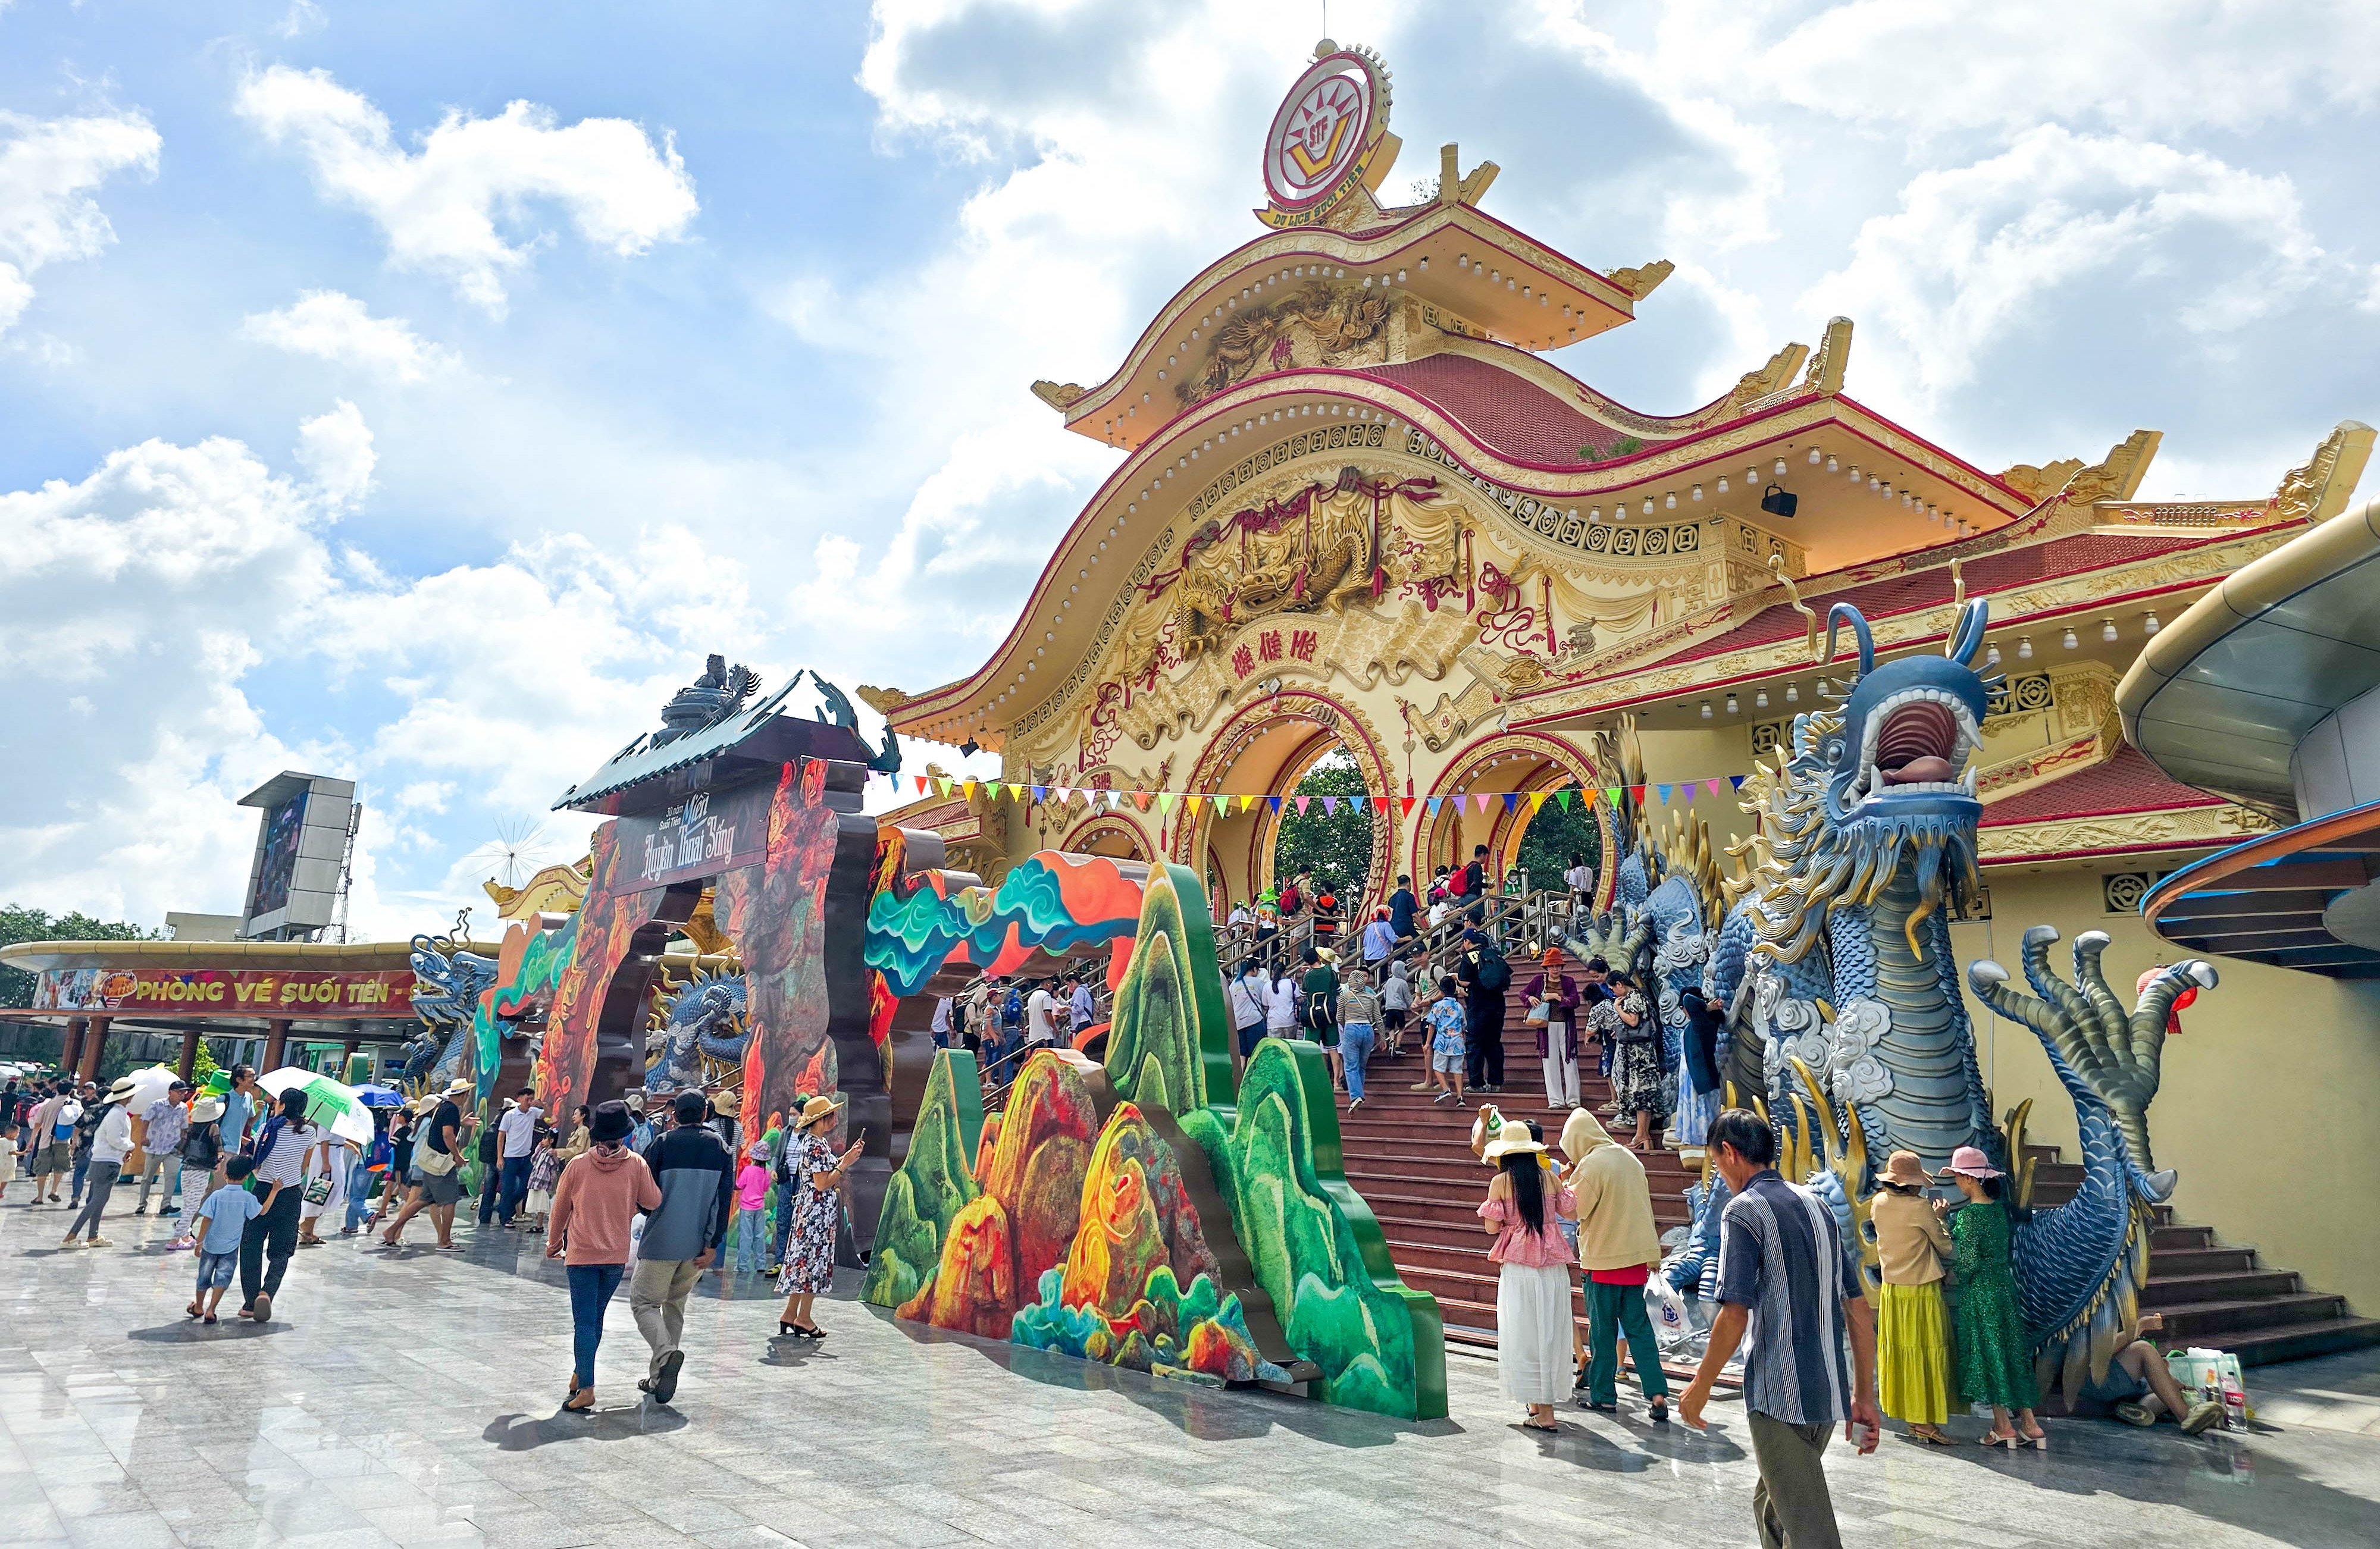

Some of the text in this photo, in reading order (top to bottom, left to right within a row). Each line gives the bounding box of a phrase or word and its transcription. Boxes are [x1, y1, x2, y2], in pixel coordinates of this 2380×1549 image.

[666, 806, 673, 817] 30
[641, 833, 674, 882] Huyền
[705, 815, 735, 864] Sống
[1258, 910, 1277, 923] 30
[136, 976, 226, 1001] PHÒNG
[234, 977, 274, 1002] VÉ
[279, 976, 342, 1003] SUỐI
[347, 979, 389, 1003] TIÊN
